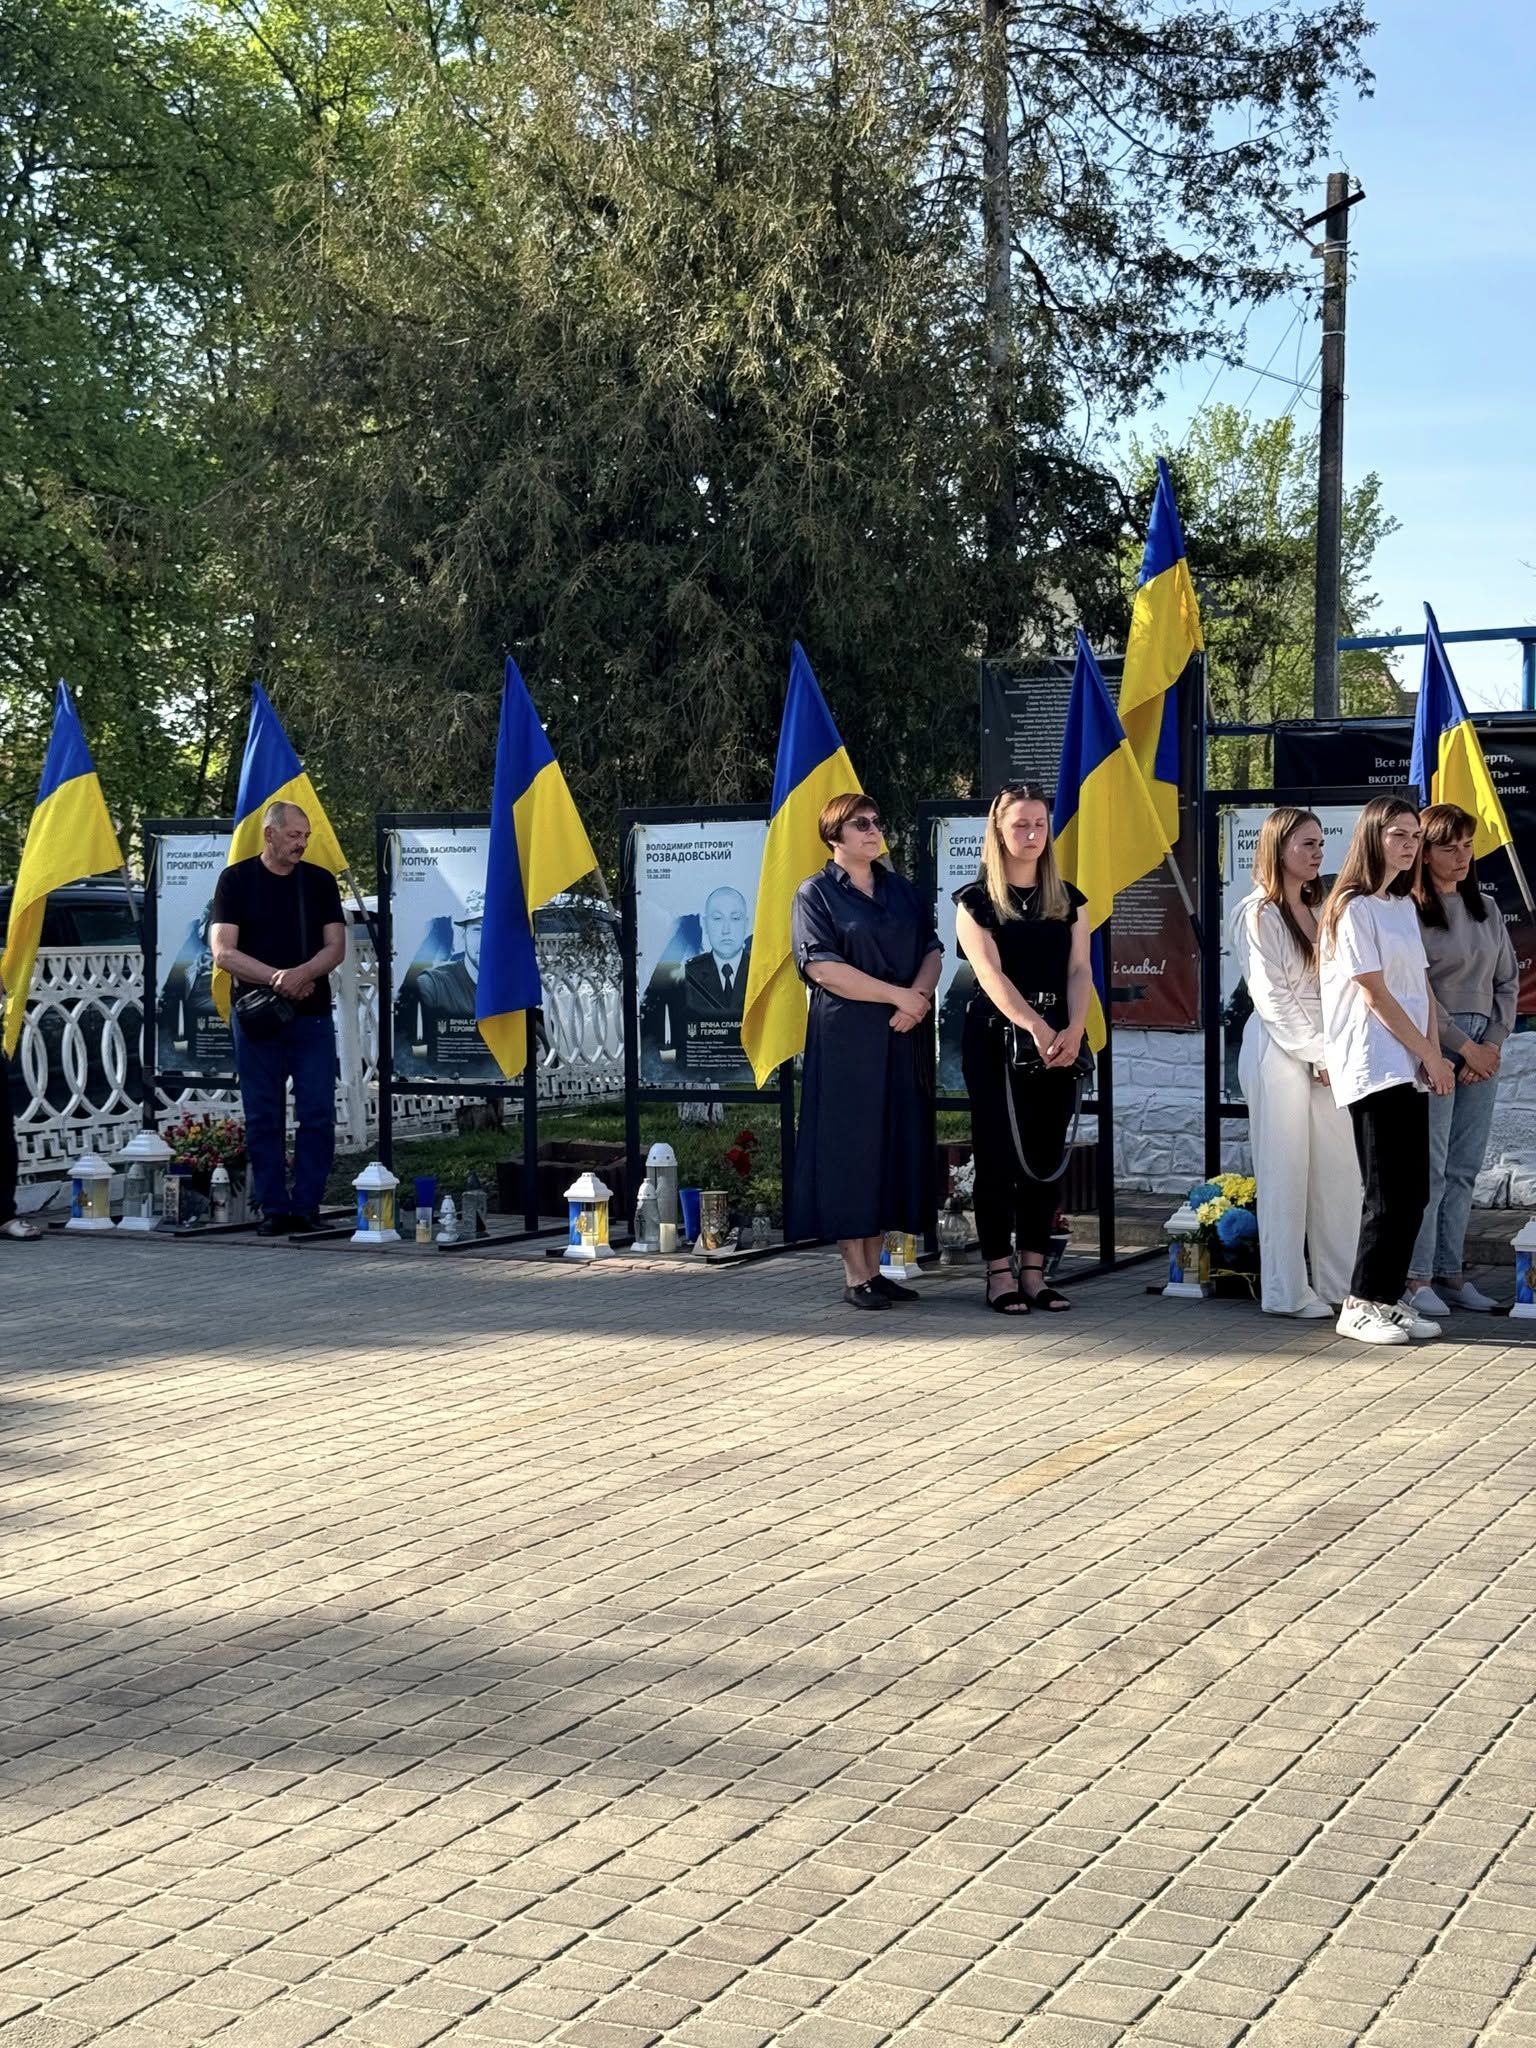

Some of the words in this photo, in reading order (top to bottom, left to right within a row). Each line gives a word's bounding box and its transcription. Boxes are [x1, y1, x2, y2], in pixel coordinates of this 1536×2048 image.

[1375, 757, 1396, 768] Все
[1398, 758, 1412, 768] ле
[1483, 754, 1514, 765] ерть,
[1368, 774, 1407, 785] вкотре
[1497, 785, 1529, 795] ання.
[1237, 829, 1262, 838] ДМИ
[1321, 827, 1343, 835] ВИЧ
[949, 835, 977, 844] СЕРГІЙ
[402, 846, 429, 854] ВАСИЛЬ
[430, 846, 477, 854] ВАСИЛЬОВИЧ
[646, 843, 693, 852] ВОЛОДИМИР
[694, 841, 733, 849] ПЕТРОВИЧ
[1237, 840, 1260, 850] КИЯ
[167, 851, 192, 859] РУСЛАН
[192, 850, 225, 858] ІВАНОВИЧ
[646, 849, 732, 863] РОЗВАДОВСЬКИЙ
[949, 847, 982, 858] СМАД
[167, 861, 214, 870] ПРОКІПЧУК
[402, 857, 438, 866] КОПЧУК
[1478, 881, 1498, 892] іка,
[1503, 913, 1521, 922] ри.
[1120, 958, 1167, 975] слава!
